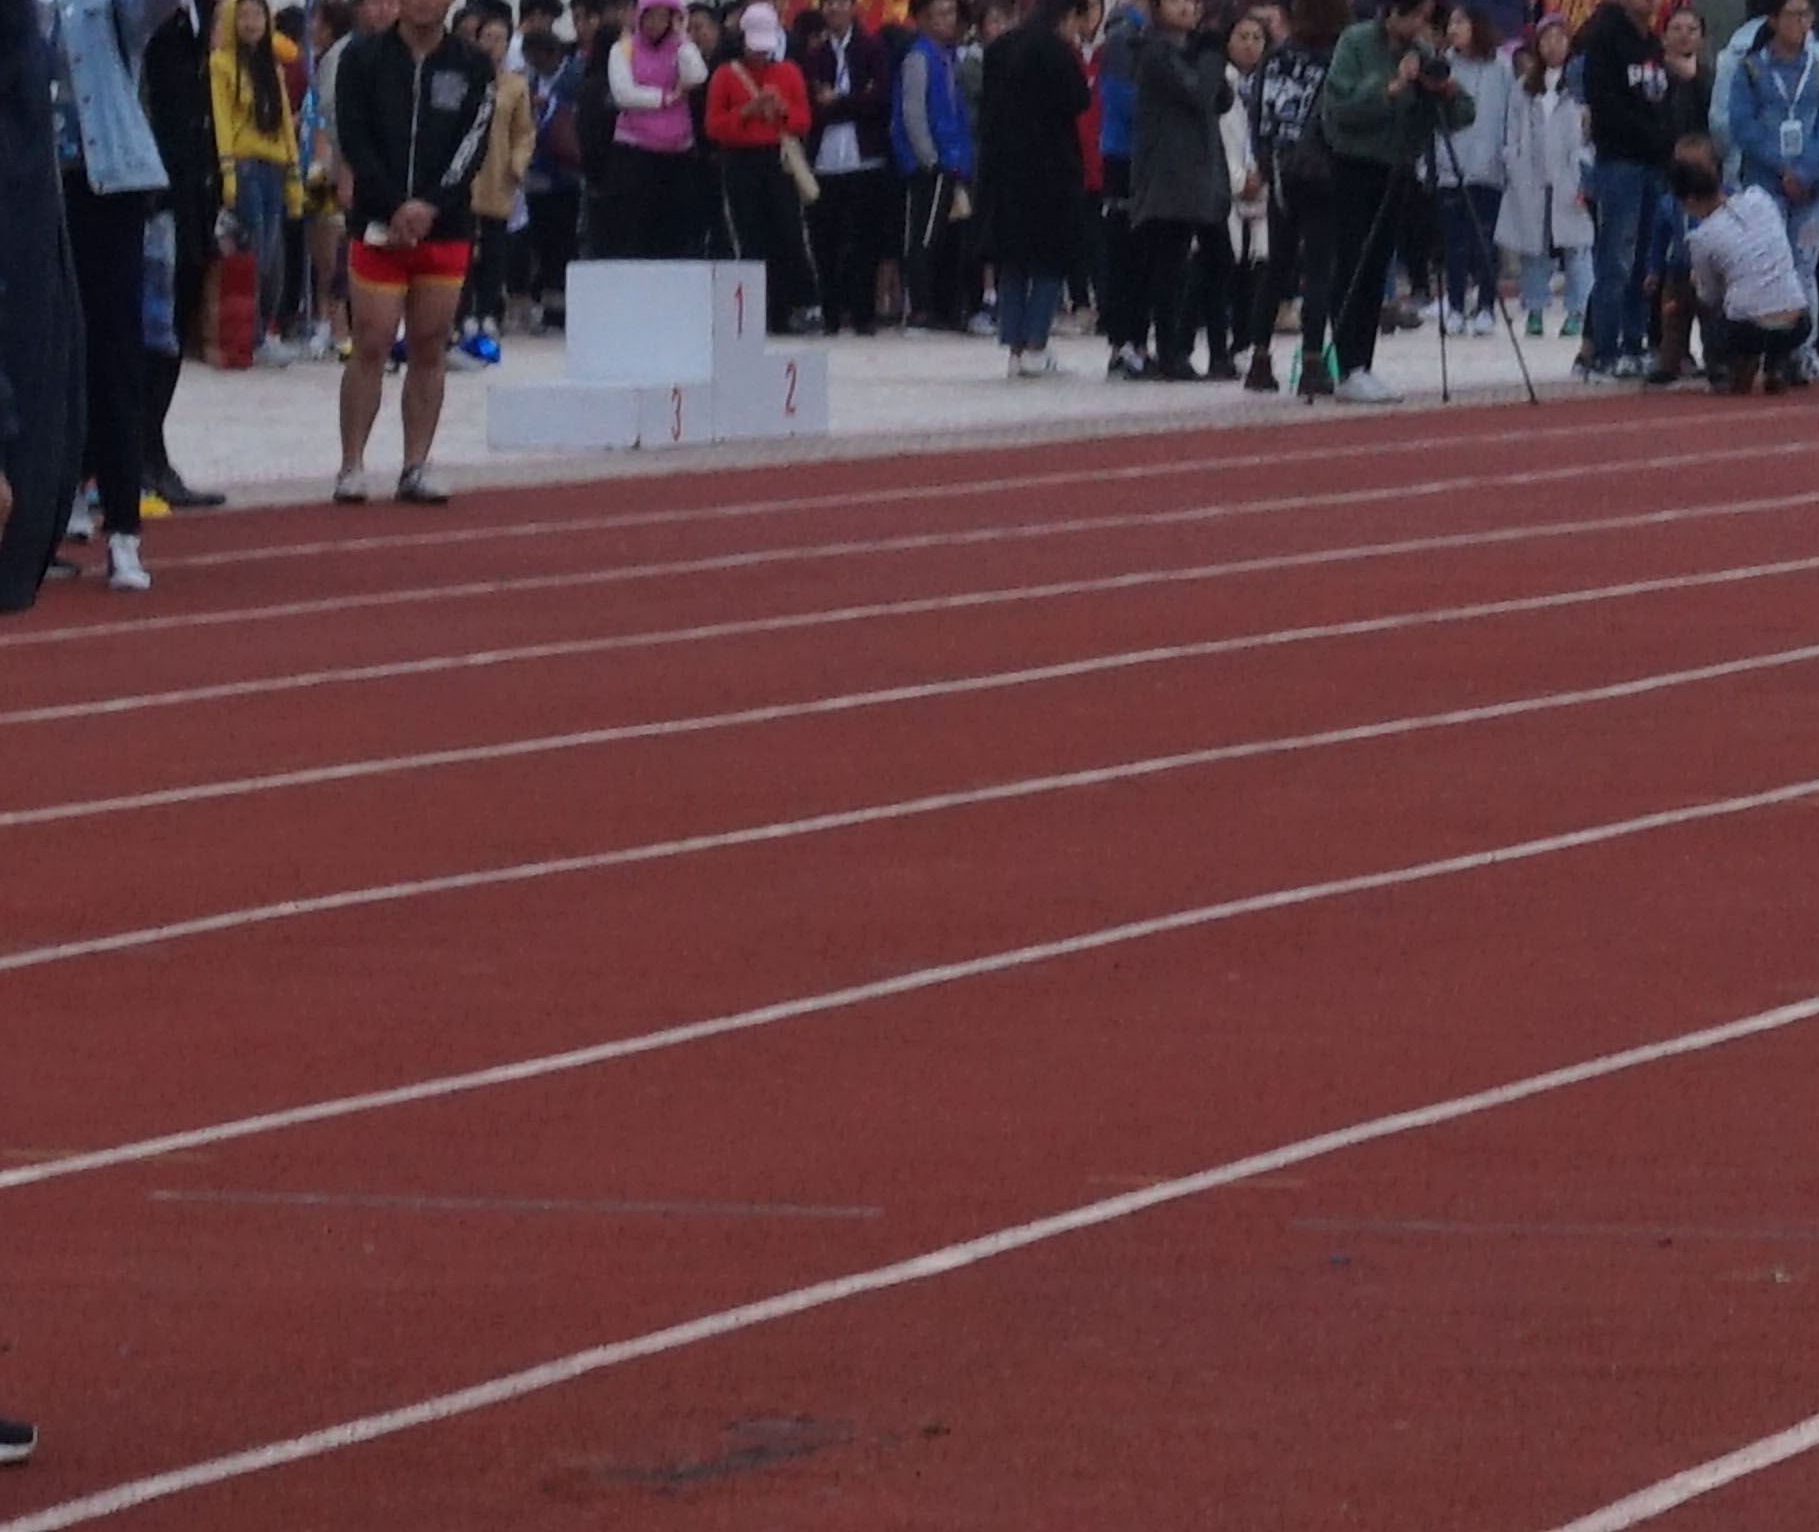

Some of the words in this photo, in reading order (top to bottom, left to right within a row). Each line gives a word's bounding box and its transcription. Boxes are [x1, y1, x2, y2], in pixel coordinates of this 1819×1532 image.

[734, 282, 744, 339] 1
[671, 386, 682, 441] 3
[786, 360, 797, 415] 2
